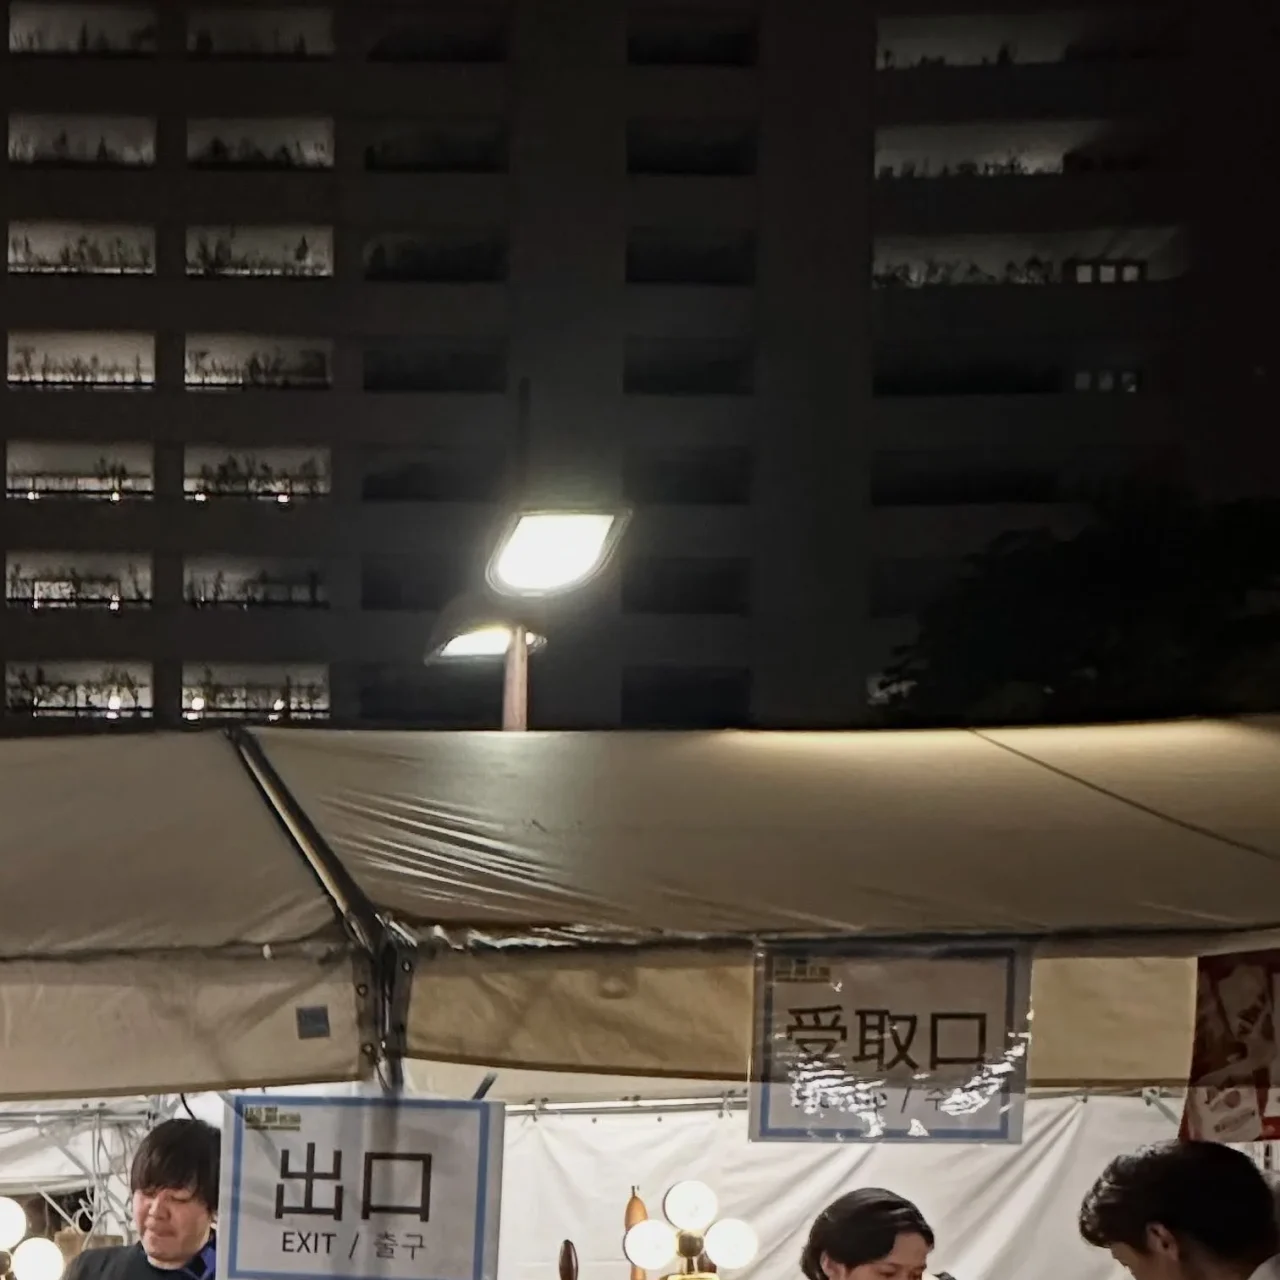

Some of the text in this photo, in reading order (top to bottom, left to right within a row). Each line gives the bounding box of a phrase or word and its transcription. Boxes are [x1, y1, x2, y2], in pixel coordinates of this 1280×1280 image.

[786, 1004, 987, 1072] 受取口
[275, 1142, 433, 1223] 出口
[282, 1230, 426, 1261] EXIT / 출구
